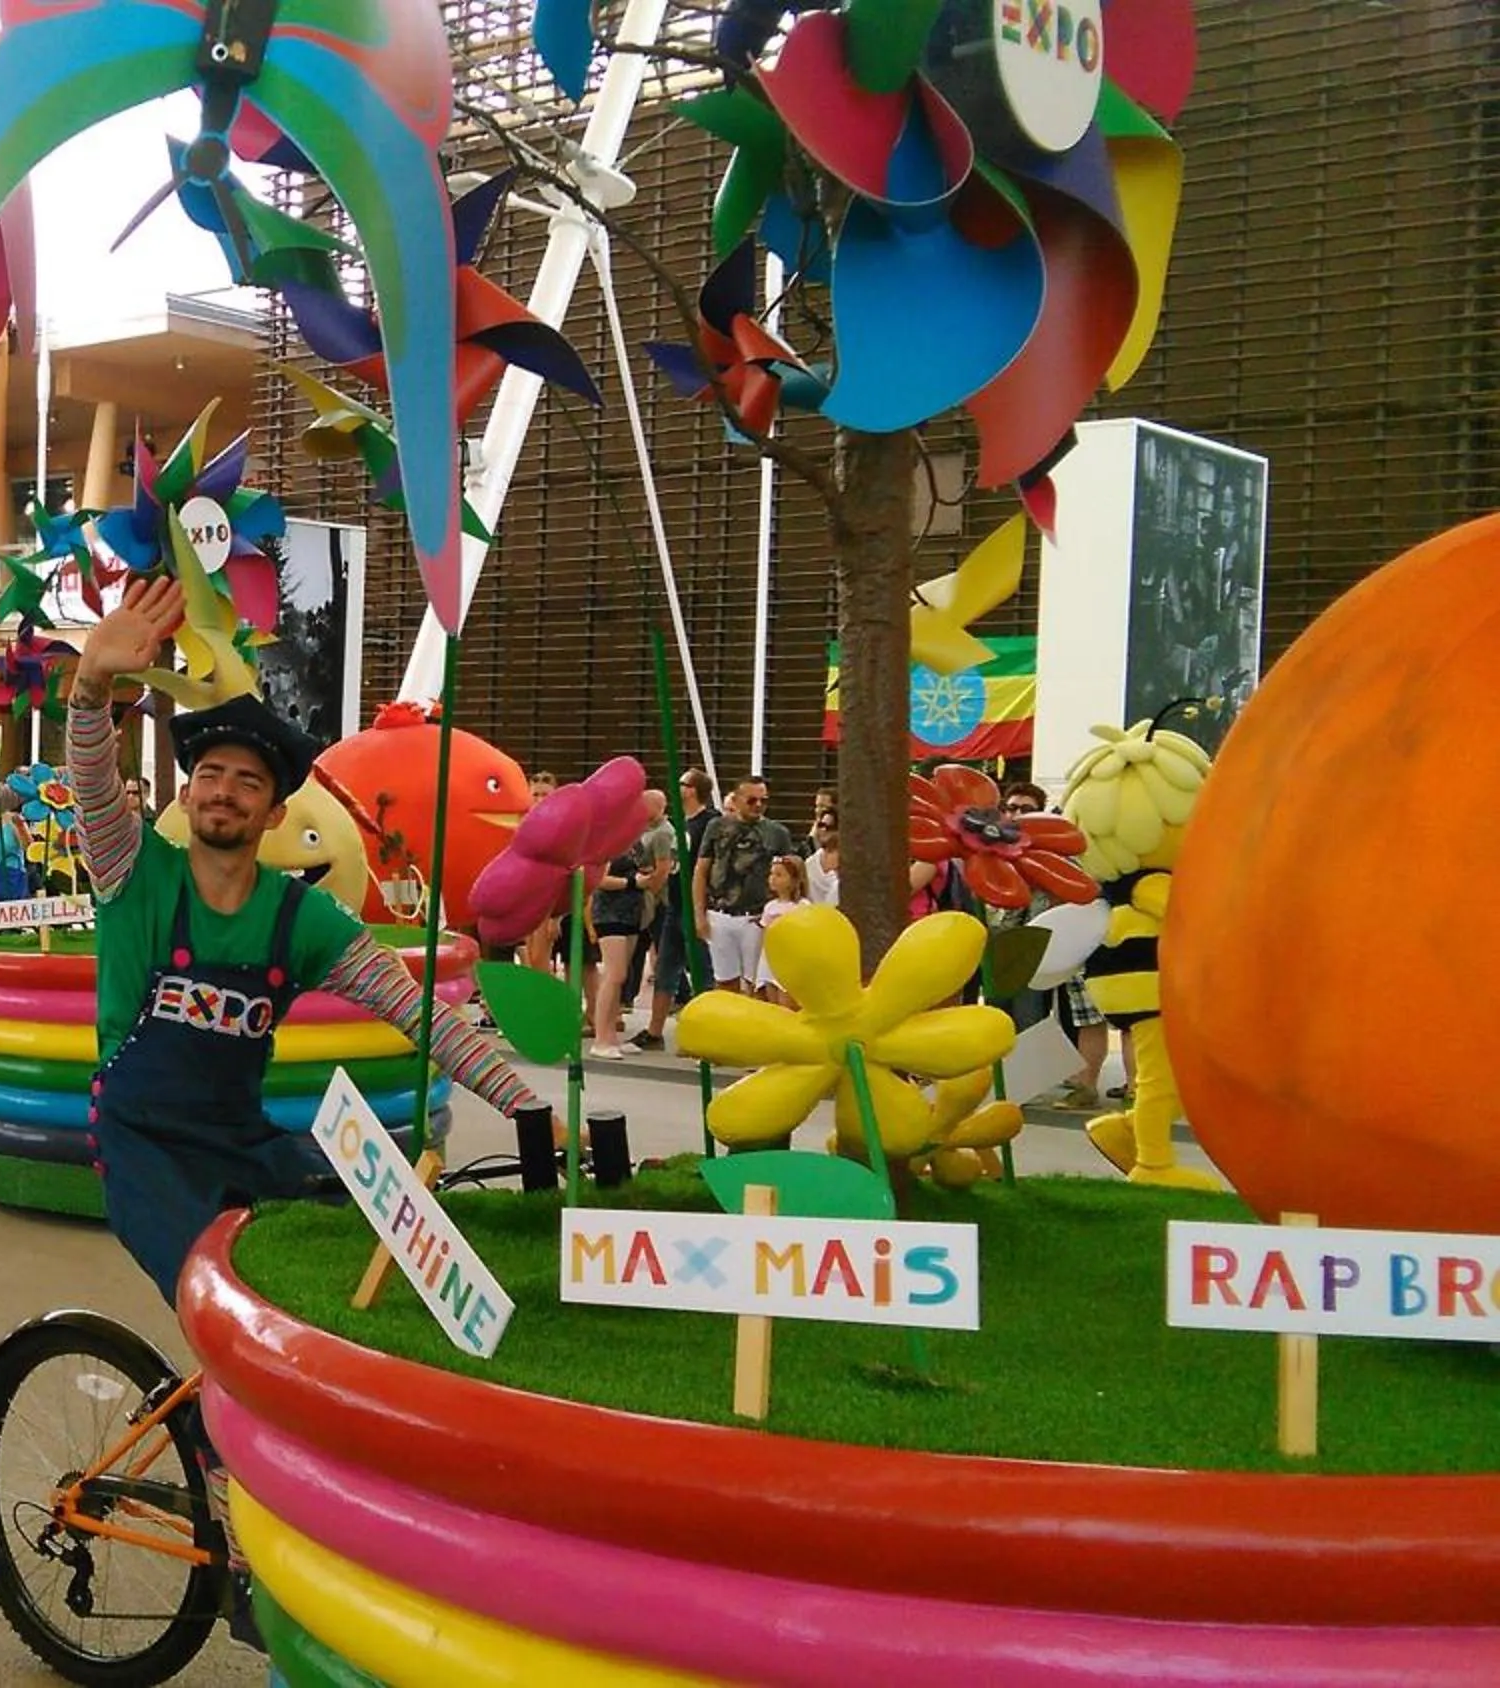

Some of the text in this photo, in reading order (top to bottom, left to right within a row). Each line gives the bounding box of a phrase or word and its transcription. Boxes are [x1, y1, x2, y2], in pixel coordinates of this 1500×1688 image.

[1001, 0, 1100, 73] EXPO
[190, 523, 229, 544] XPO
[151, 975, 273, 1039] EXPO
[570, 1230, 731, 1290] MAX
[1190, 1244, 1500, 1318] RAP BR
